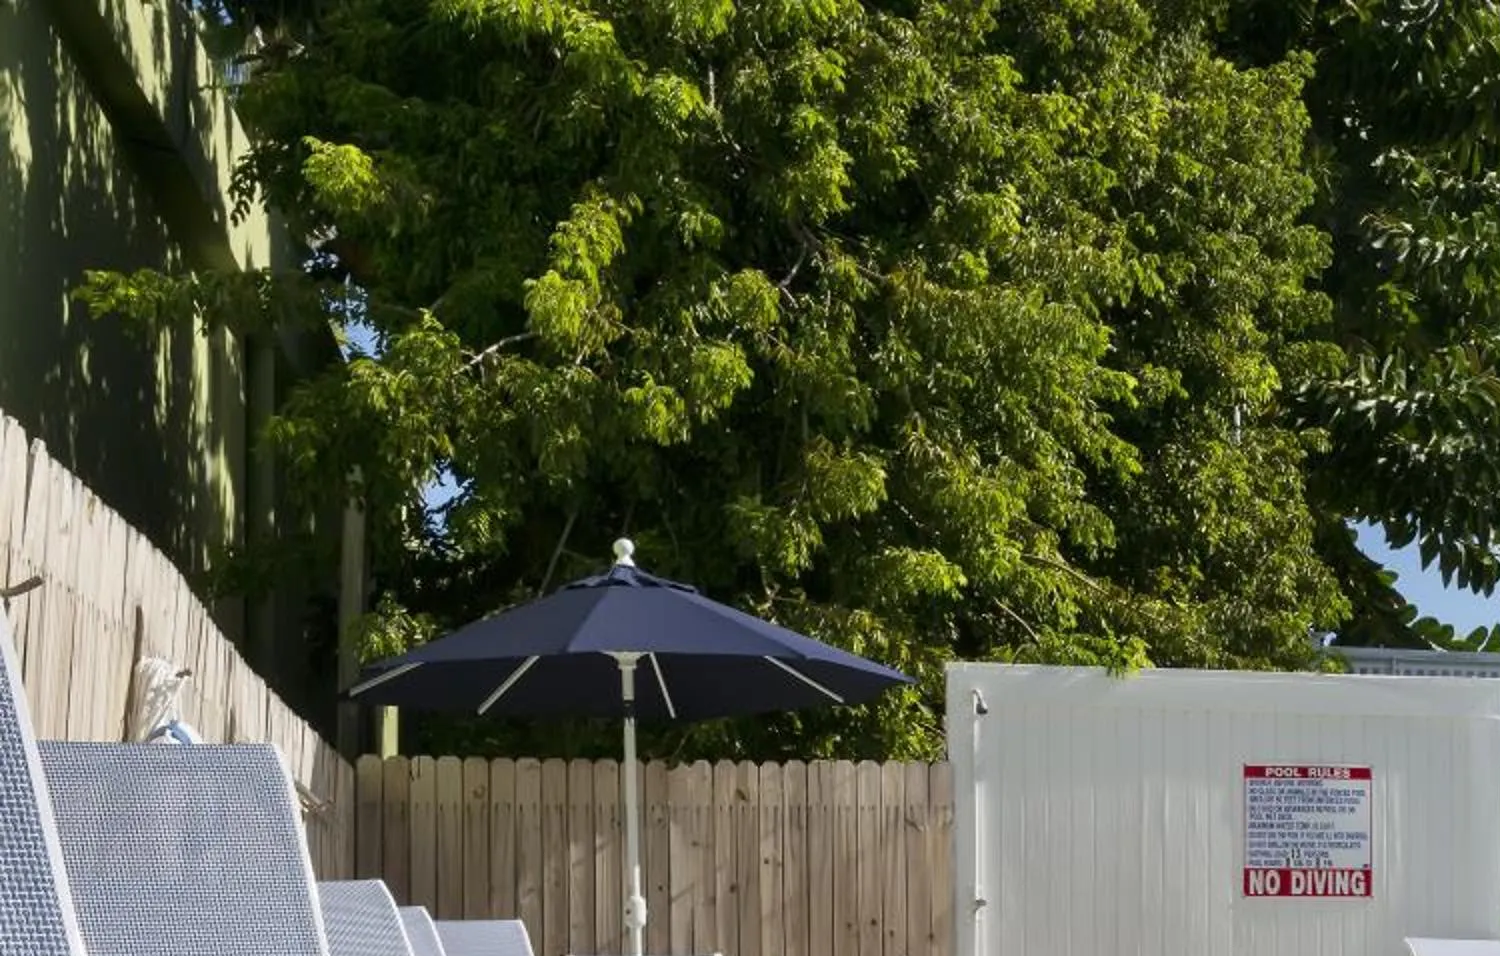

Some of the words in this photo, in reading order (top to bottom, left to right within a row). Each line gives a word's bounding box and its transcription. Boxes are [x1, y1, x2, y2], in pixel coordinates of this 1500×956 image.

[1264, 767, 1302, 777] POOL
[1307, 767, 1351, 779] RULES
[1248, 869, 1281, 895] NO
[1290, 869, 1366, 896] DIVING
